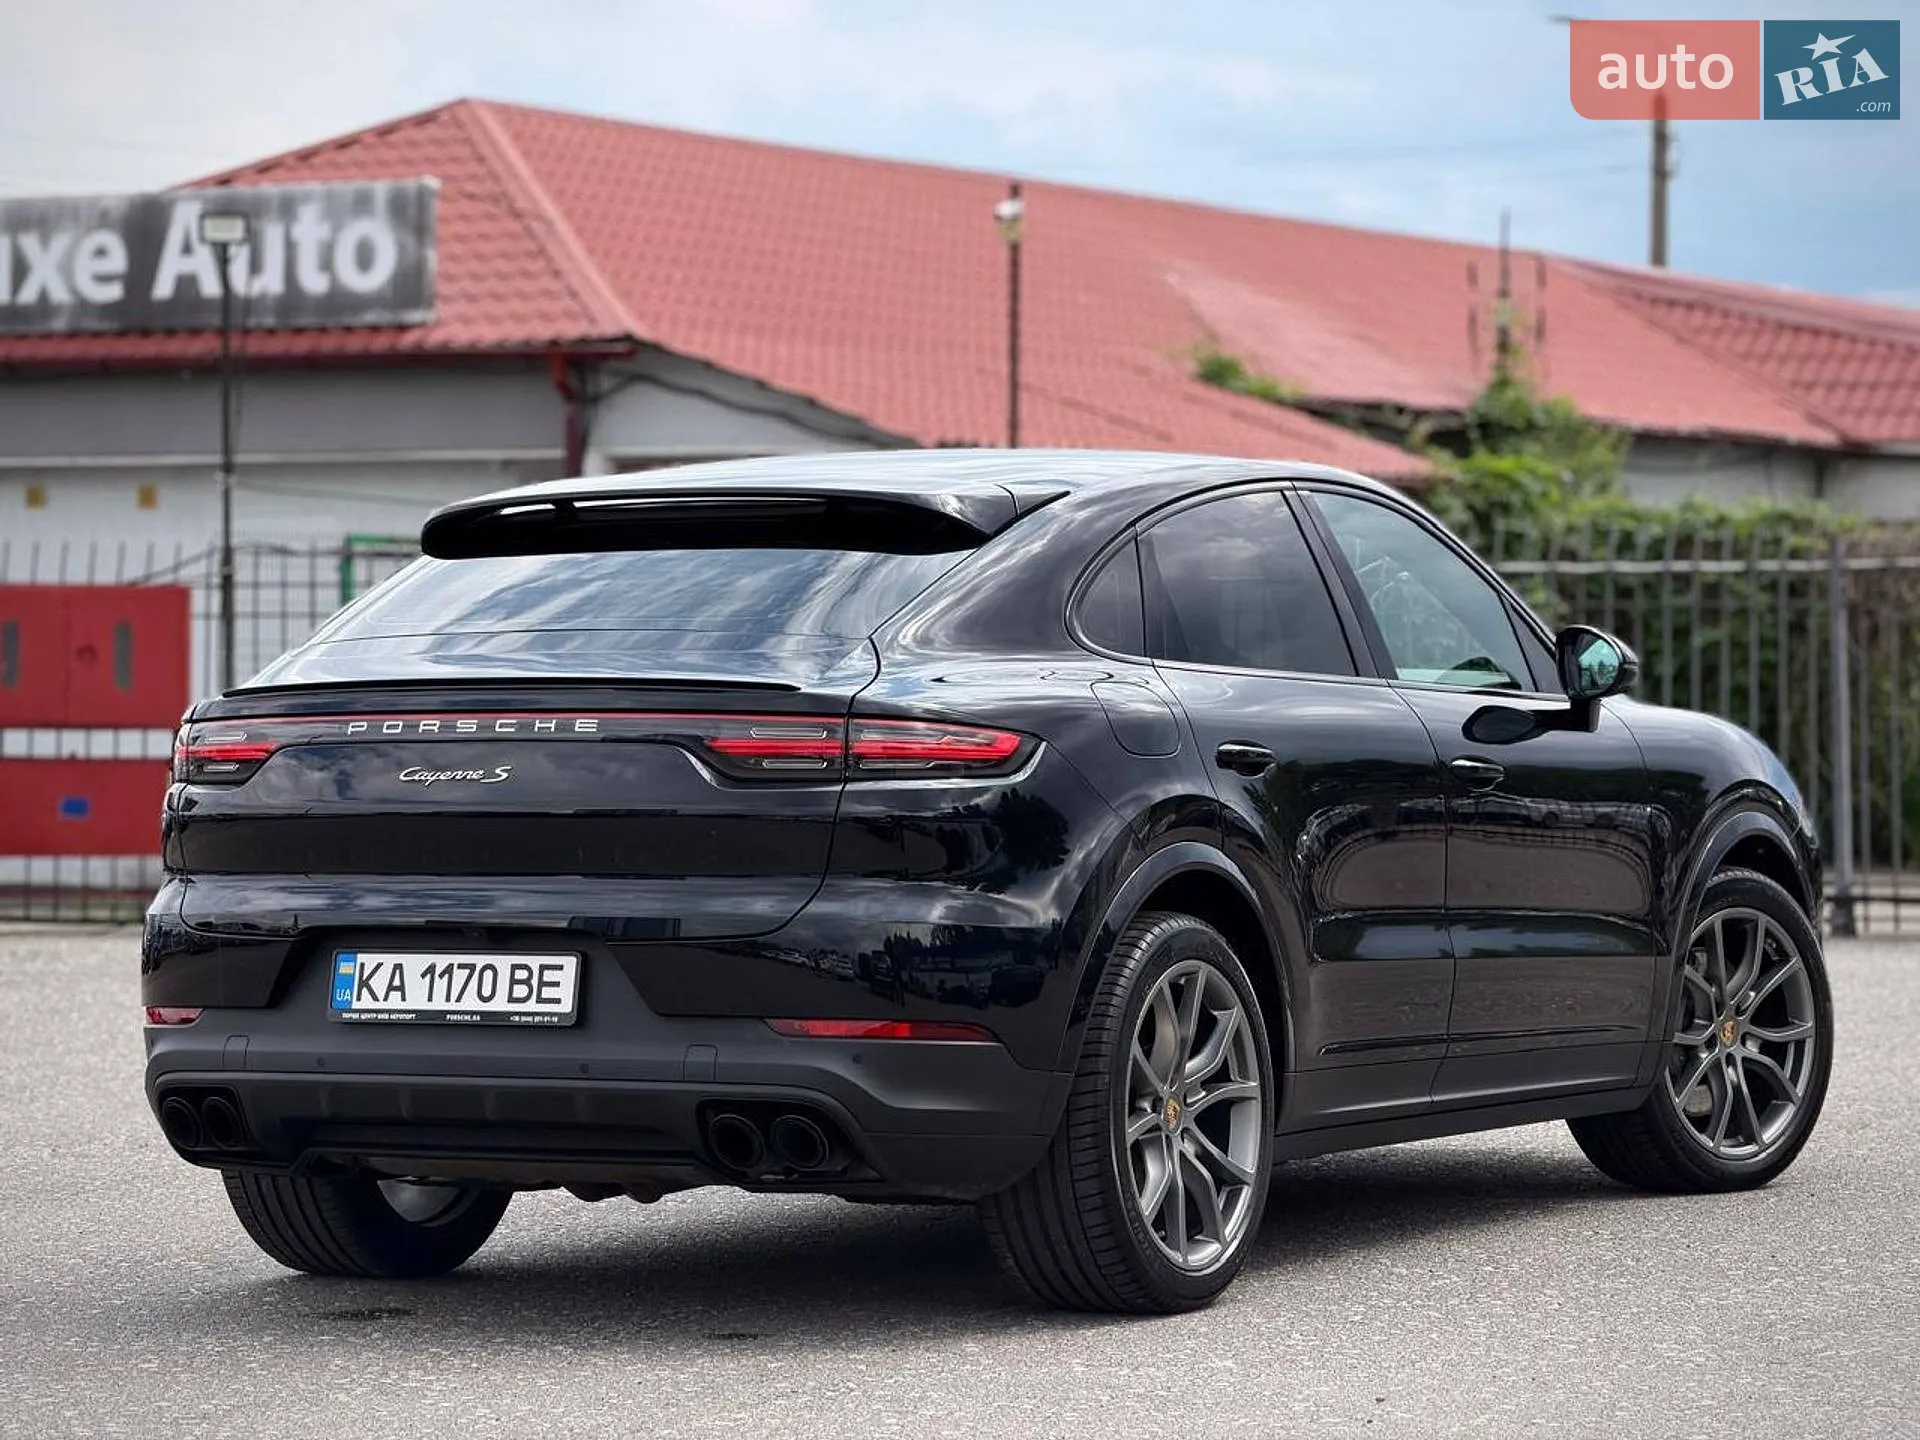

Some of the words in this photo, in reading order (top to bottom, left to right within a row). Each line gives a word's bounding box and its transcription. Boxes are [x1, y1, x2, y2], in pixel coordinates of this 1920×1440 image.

[0, 229, 129, 305] xe
[150, 200, 398, 302] Auto
[347, 719, 599, 735] PORSCHE
[399, 766, 484, 786] Cayenne
[480, 766, 512, 784] S
[356, 962, 407, 1003] KA
[420, 962, 498, 1004] 1170
[507, 963, 564, 1005] BE
[336, 988, 351, 1001] UA
